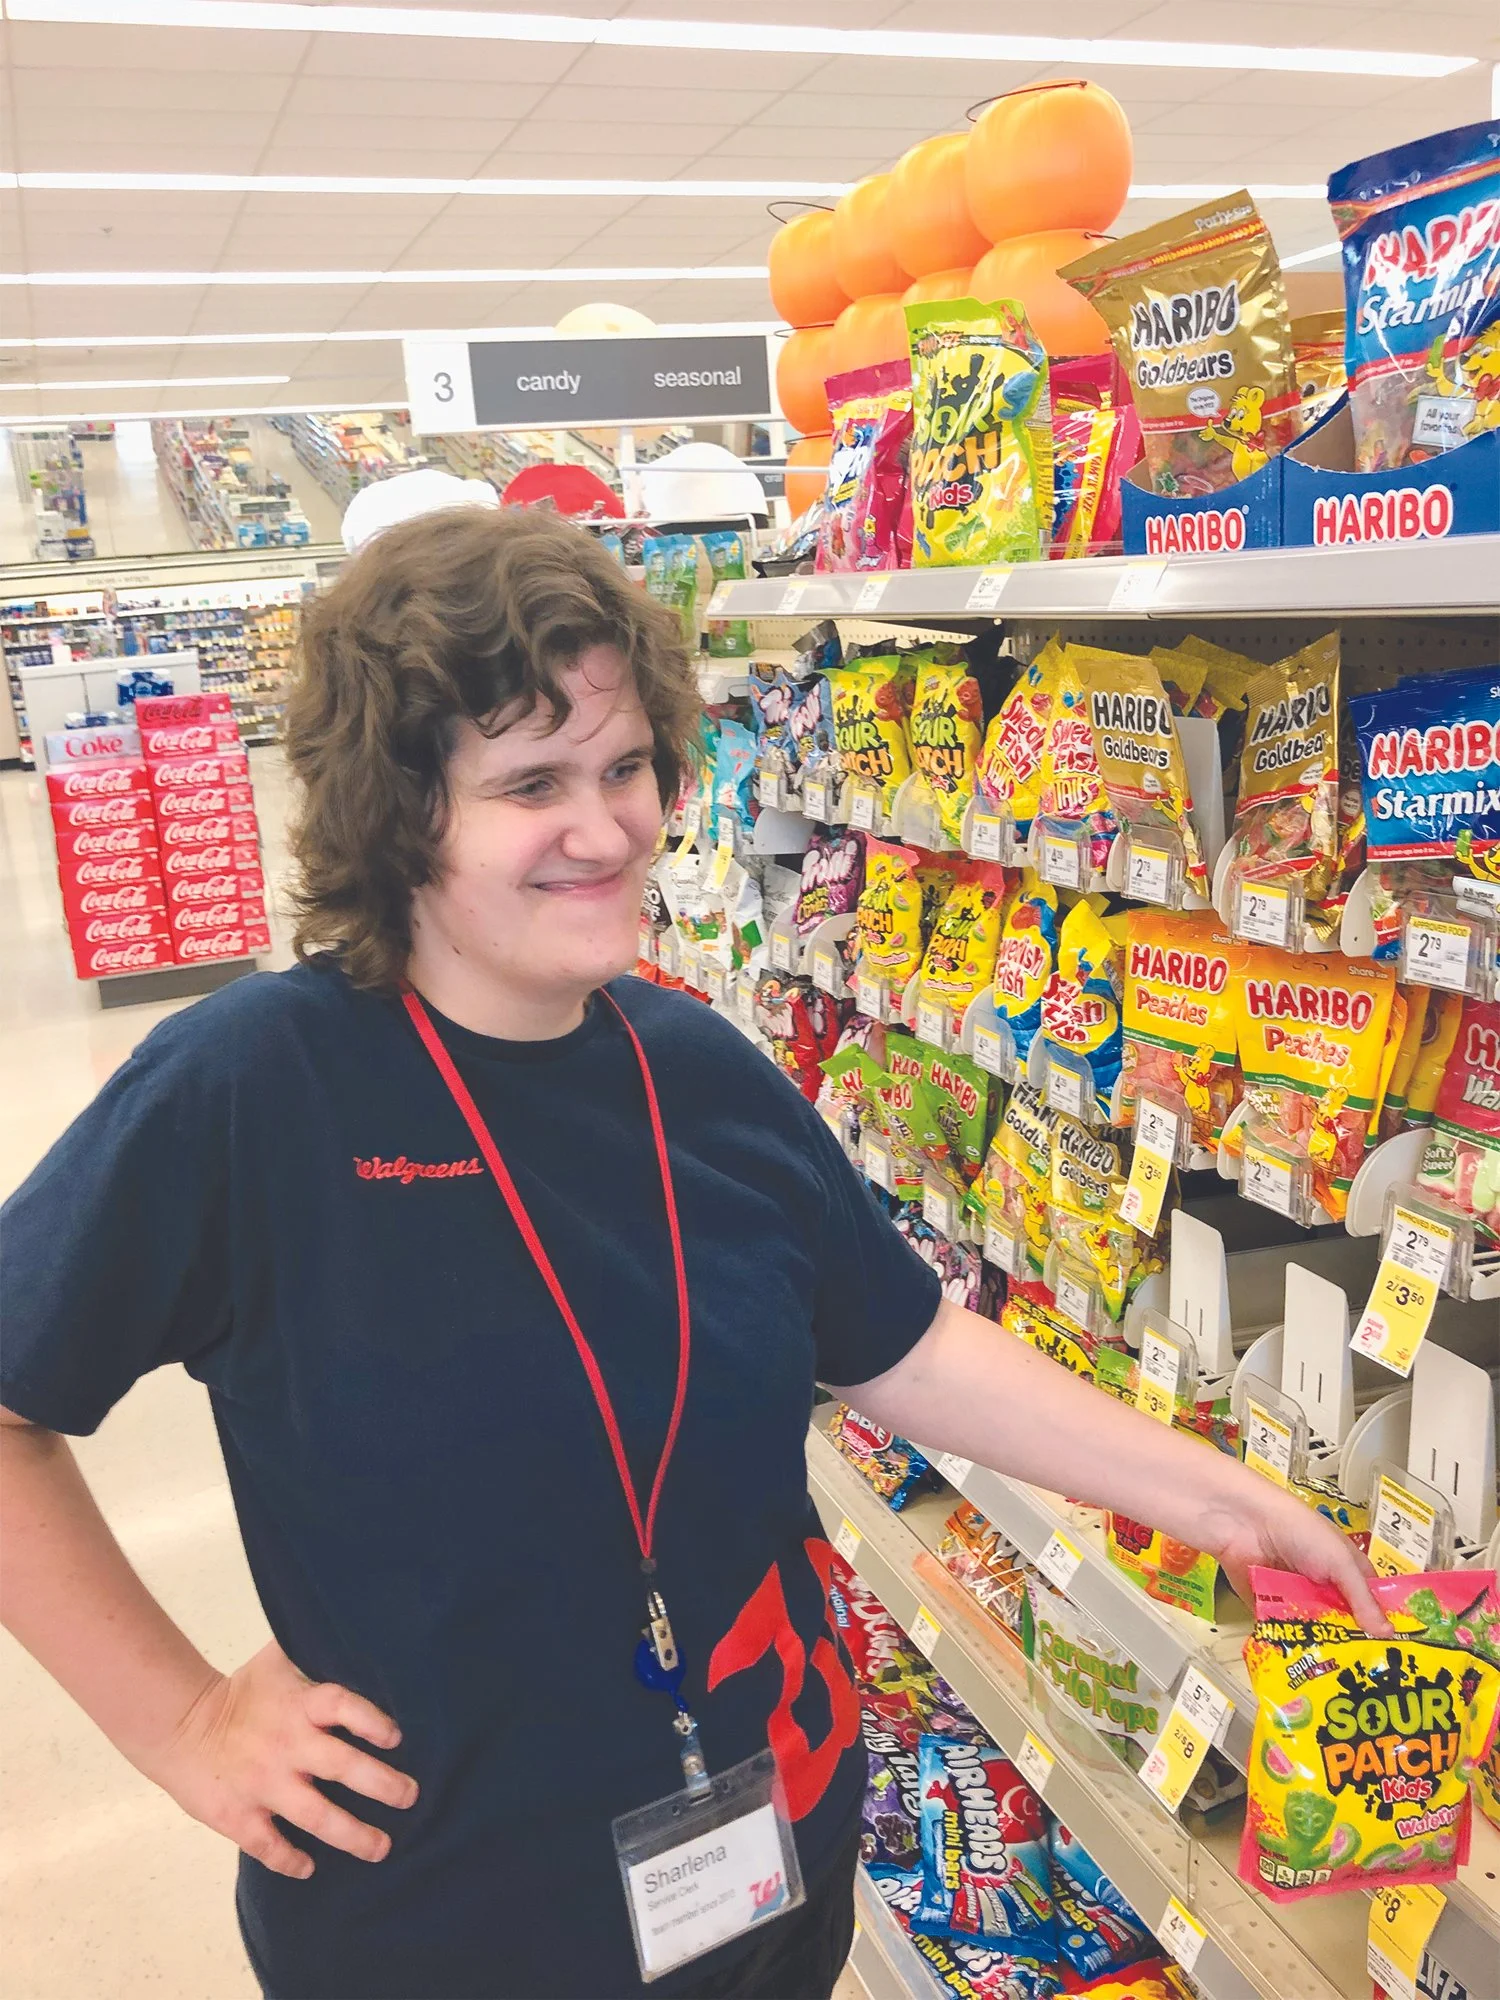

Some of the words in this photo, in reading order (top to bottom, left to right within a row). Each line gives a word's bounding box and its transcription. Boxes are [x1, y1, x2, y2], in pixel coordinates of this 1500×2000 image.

[1133, 283, 1239, 348] HARIBO
[516, 370, 581, 394] candy
[654, 366, 742, 388] seasonal
[1137, 352, 1235, 388] Goldbears
[434, 372, 455, 402] 3
[929, 483, 974, 510] Kids
[1313, 485, 1454, 546] HARIBO
[1146, 511, 1246, 554] HARIBO
[65, 735, 123, 758] Coke
[149, 727, 216, 752] Coca-Cola
[1102, 736, 1170, 769] Goldbears
[1368, 721, 1500, 780] HARIB
[64, 769, 132, 797] Coca-Cola
[155, 760, 222, 786] Coca-Cola
[160, 788, 228, 816] Coca-Cola
[1055, 776, 1098, 810] TAILS
[1376, 781, 1500, 820] Starmix
[69, 799, 137, 826] Coca-Cola
[74, 828, 140, 856] Coca-Cola
[164, 817, 230, 845] Coca-Cola
[76, 857, 144, 884] Coca-Cola
[166, 847, 230, 874] Coca-Cola
[1136, 858, 1151, 878] 279
[81, 886, 148, 914] Coca-Cola
[172, 875, 238, 903] Coca-Cola
[175, 903, 240, 931] Coca-Cola
[1249, 895, 1267, 917] 279
[86, 914, 153, 943] Coca-Cola
[1212, 932, 1233, 944] Share
[91, 942, 157, 970] Coca-Cola
[179, 931, 244, 959] Coca-Cola
[1418, 933, 1442, 958] 279
[1131, 945, 1228, 993] HARIBO
[1349, 965, 1374, 977] Share
[1136, 988, 1208, 1026] Peaches
[1247, 980, 1374, 1032] HARIBO
[1264, 1025, 1350, 1067] Peaches
[1149, 1113, 1163, 1130] 279
[353, 1156, 484, 1184] Walgreens
[1253, 1161, 1271, 1182] 279
[1423, 1159, 1453, 1172] Sweet
[1406, 1230, 1430, 1250] 279
[1385, 1279, 1425, 1306] 2/350
[1260, 1426, 1276, 1444] 279
[1113, 1511, 1153, 1549] BIG
[1391, 1511, 1413, 1531] 279
[1255, 1622, 1306, 1642] SHARE
[1312, 1624, 1351, 1642] SIZE
[1038, 1619, 1141, 1694] Caramel
[1287, 1654, 1318, 1681] SOUR
[1093, 1676, 1160, 1735] Pops
[1192, 1684, 1212, 1703] 579
[1326, 1689, 1454, 1741] SOUR
[1322, 1732, 1459, 1788] PATCH
[1381, 1777, 1433, 1803] Kids
[945, 1743, 1008, 1876] AIRHEADS
[943, 1811, 962, 1846] mini
[644, 1846, 728, 1894] Sharlena
[945, 1848, 962, 1891] bars
[1059, 1898, 1098, 1933] bars
[912, 1933, 956, 1973] mini
